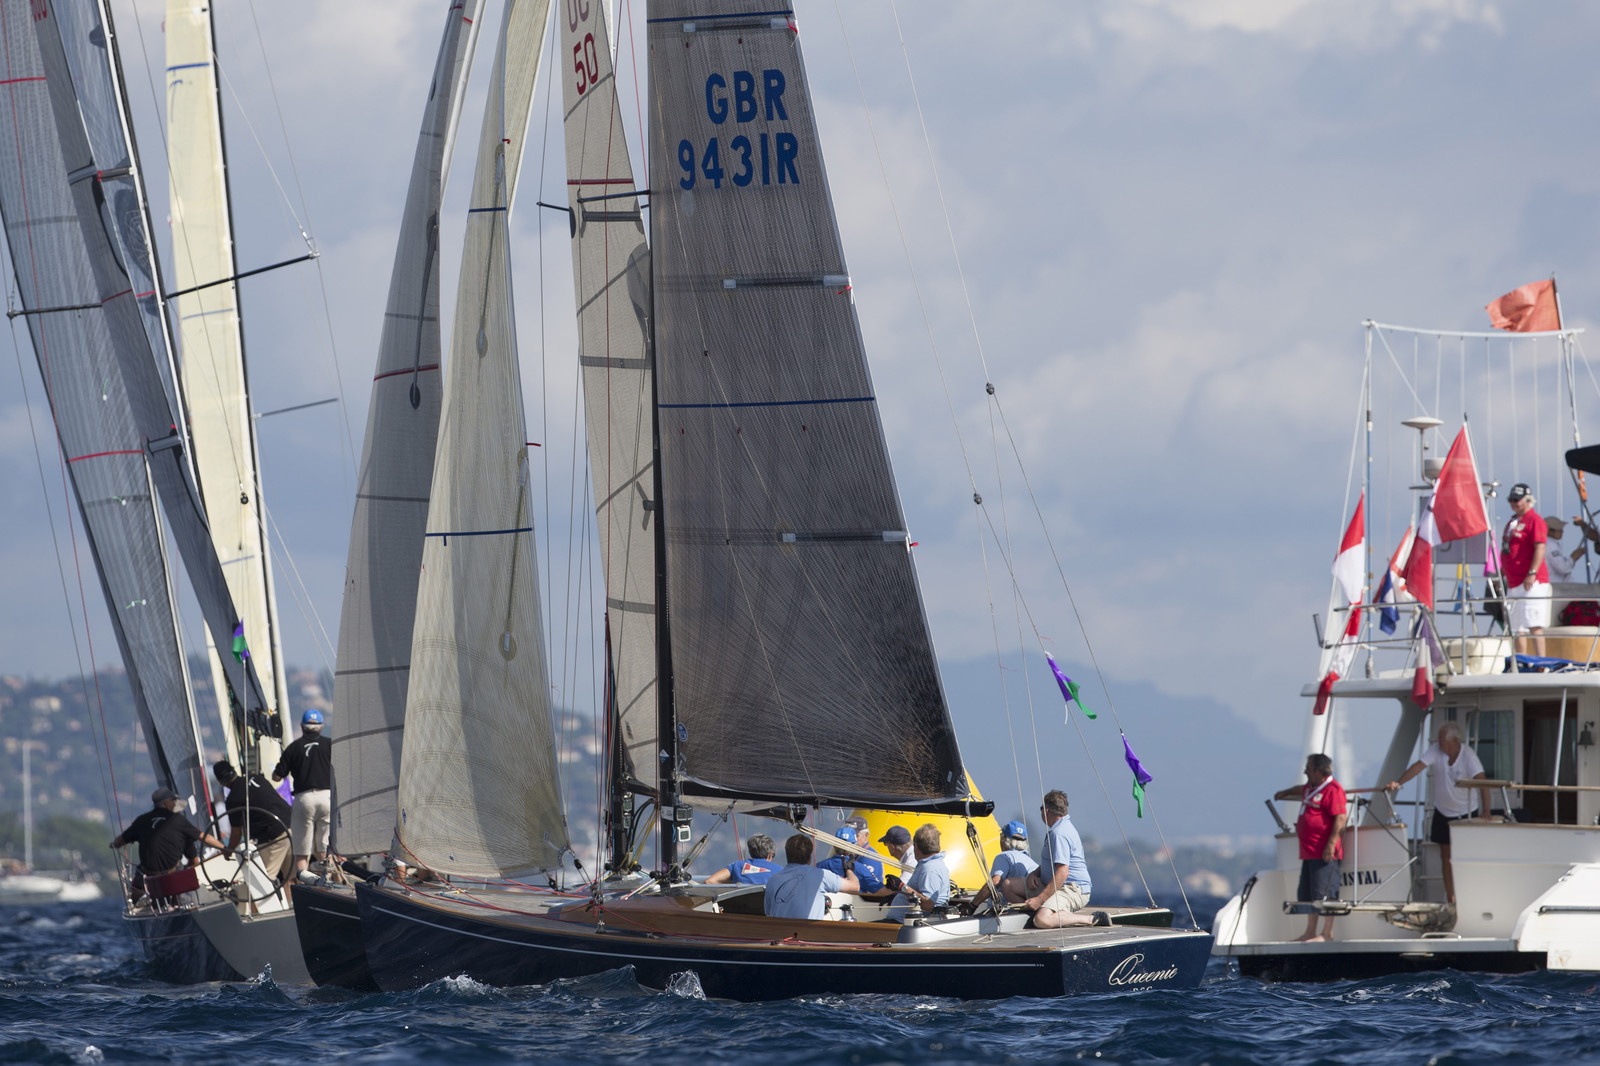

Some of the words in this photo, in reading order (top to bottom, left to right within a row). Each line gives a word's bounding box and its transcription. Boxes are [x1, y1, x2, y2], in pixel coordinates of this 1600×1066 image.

[573, 32, 598, 95] 50
[706, 69, 788, 124] GBR
[1340, 870, 1381, 886] ISTAL
[1108, 953, 1178, 985] Queenie
